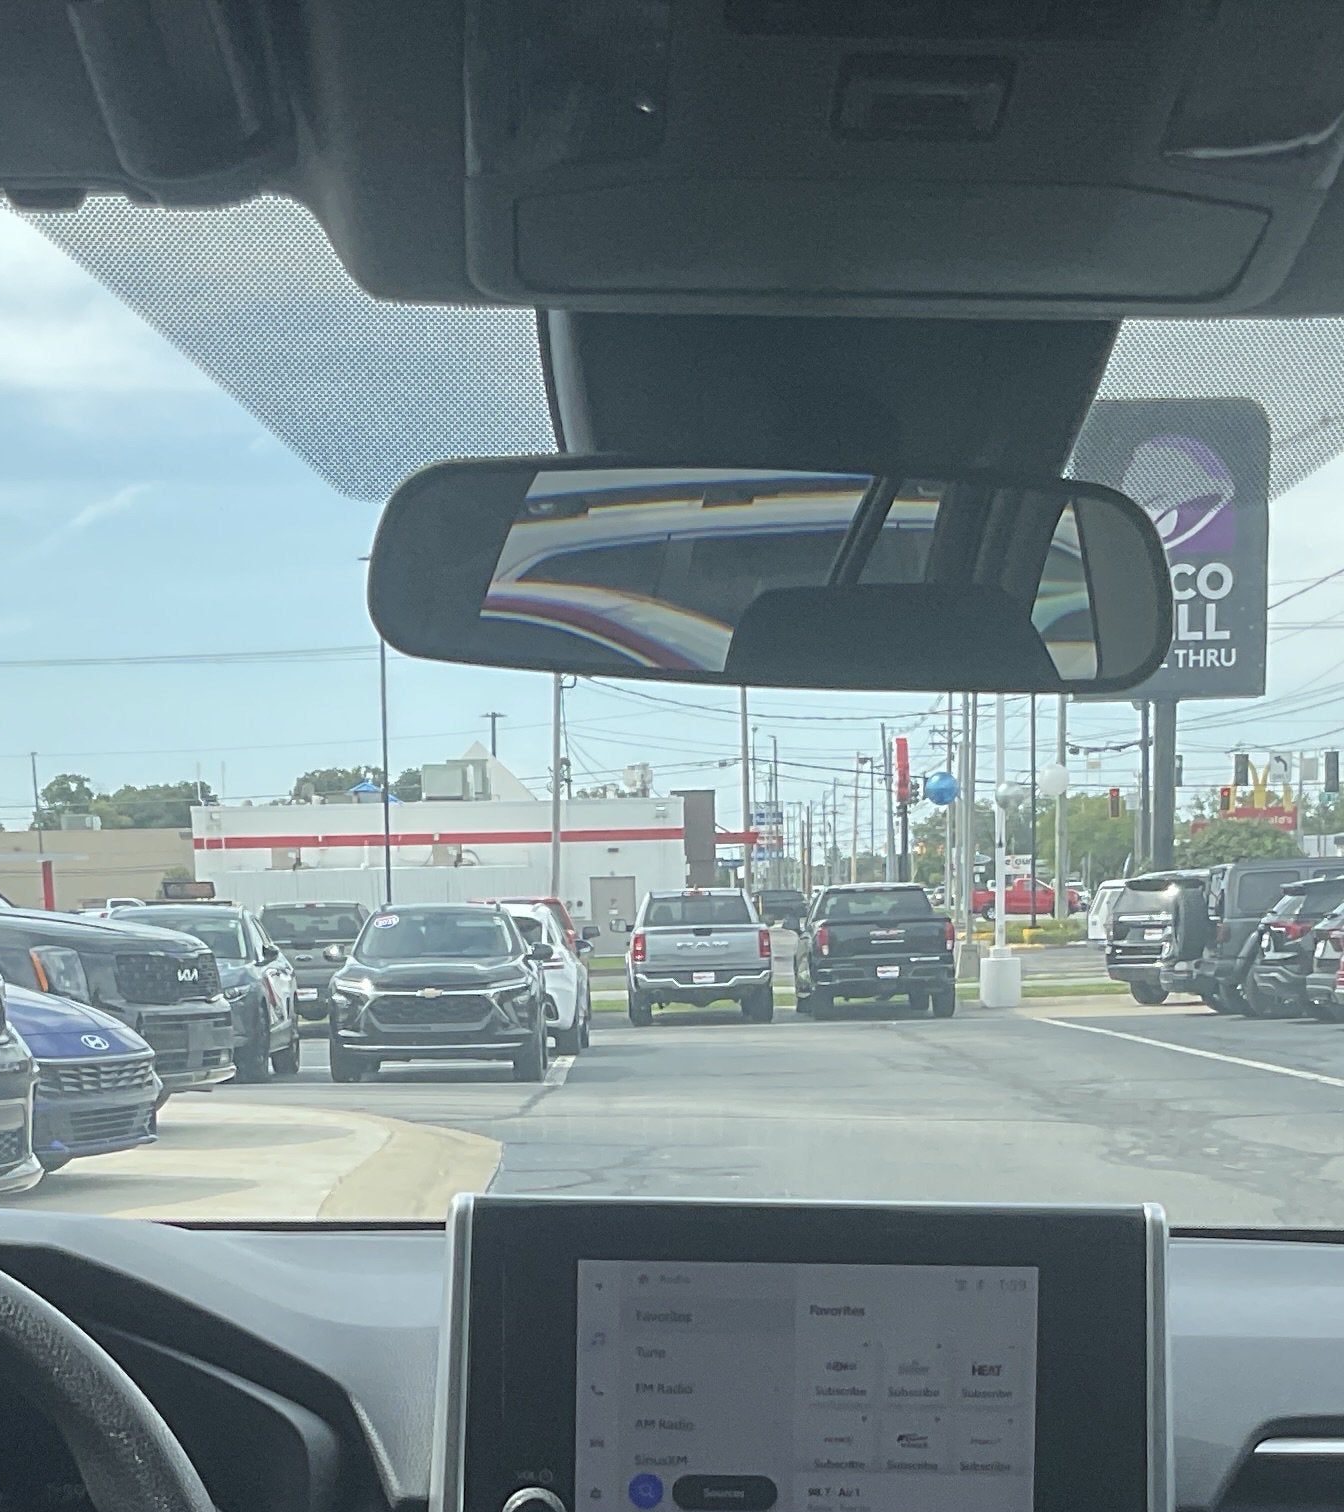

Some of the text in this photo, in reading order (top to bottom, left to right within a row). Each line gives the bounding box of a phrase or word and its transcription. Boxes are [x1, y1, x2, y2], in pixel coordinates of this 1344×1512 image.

[1170, 562, 1234, 600] CO
[1176, 602, 1231, 641] LL
[1174, 647, 1237, 669] THRU
[635, 1310, 693, 1322] Favorites
[809, 1305, 866, 1317] Favorites
[636, 1346, 667, 1359] Tune
[972, 1364, 1002, 1377] HEAT
[657, 1383, 693, 1394] Radio
[815, 1386, 867, 1397] Subscribe
[887, 1386, 940, 1398] Subscribe
[961, 1388, 1013, 1399] Subscribe
[635, 1419, 695, 1431] AM Radio
